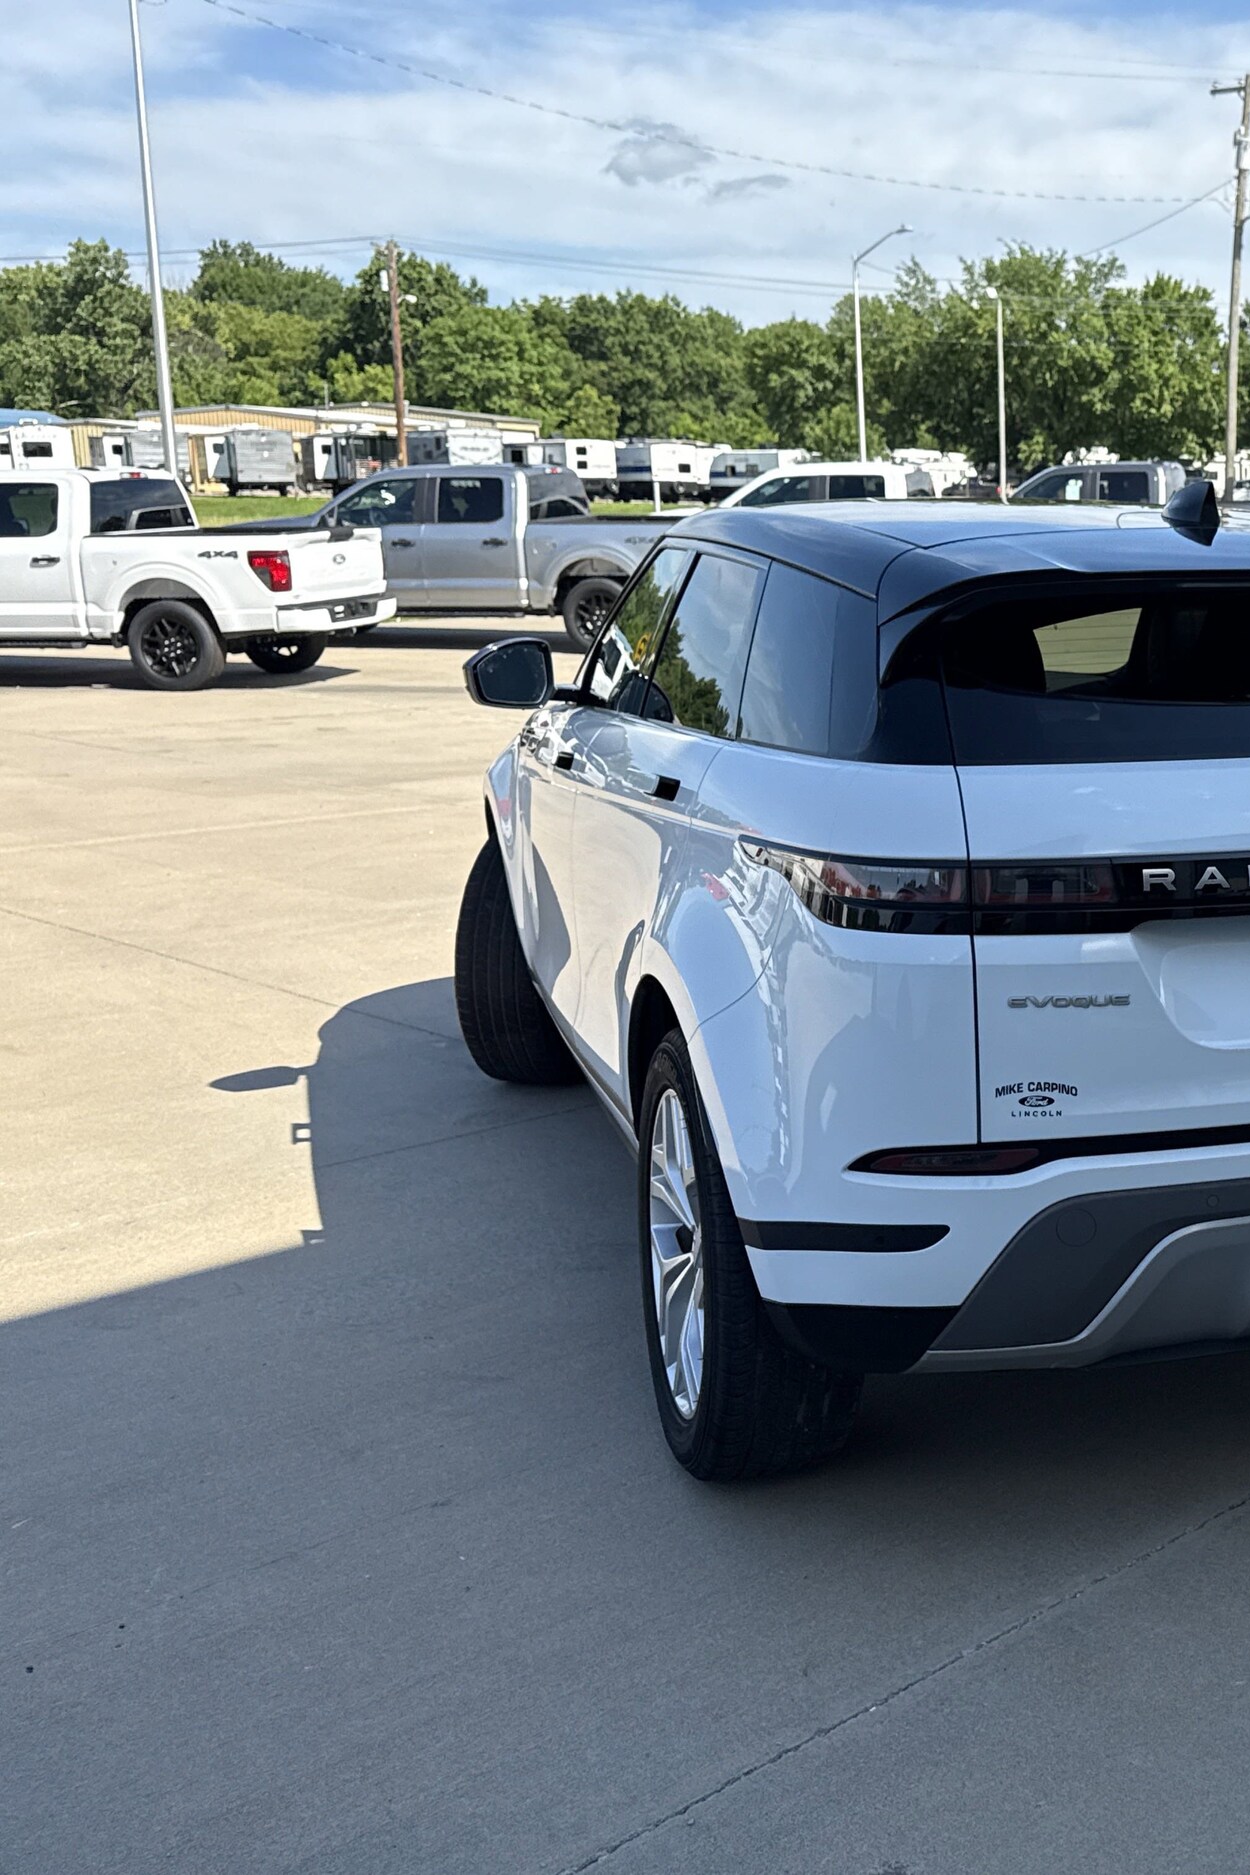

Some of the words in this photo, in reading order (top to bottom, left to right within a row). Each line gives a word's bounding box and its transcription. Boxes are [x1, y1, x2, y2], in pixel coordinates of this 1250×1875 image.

[1007, 994, 1131, 1009] EVOQUE
[995, 1082, 1024, 1098] MIKE
[1027, 1081, 1078, 1097] CARPINO
[1024, 1096, 1049, 1106] Ford
[1011, 1110, 1062, 1118] LINCOLN
